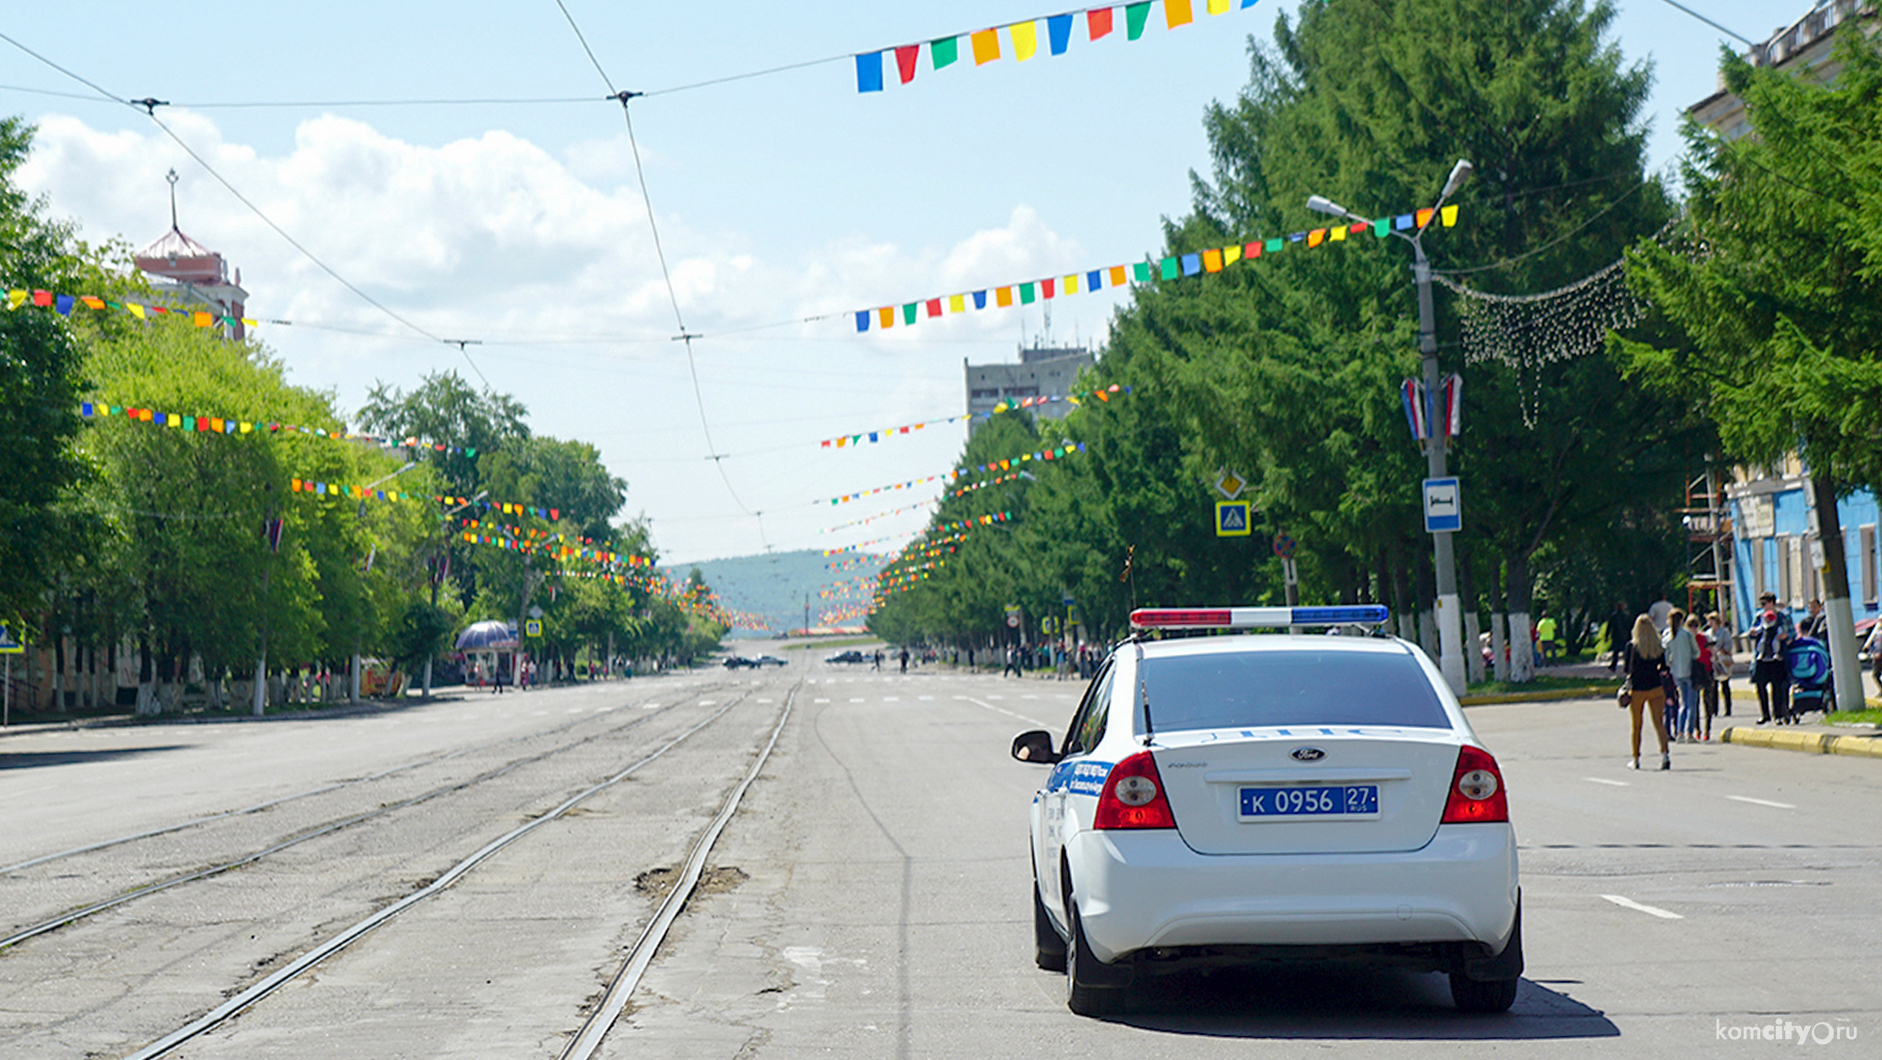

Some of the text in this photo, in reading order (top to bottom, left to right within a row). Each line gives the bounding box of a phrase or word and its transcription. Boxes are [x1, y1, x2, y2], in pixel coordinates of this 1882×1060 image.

[1297, 749, 1320, 760] Ford
[1275, 790, 1333, 813] 0956
[1347, 787, 1369, 805] 27
[1349, 804, 1368, 812] RUS
